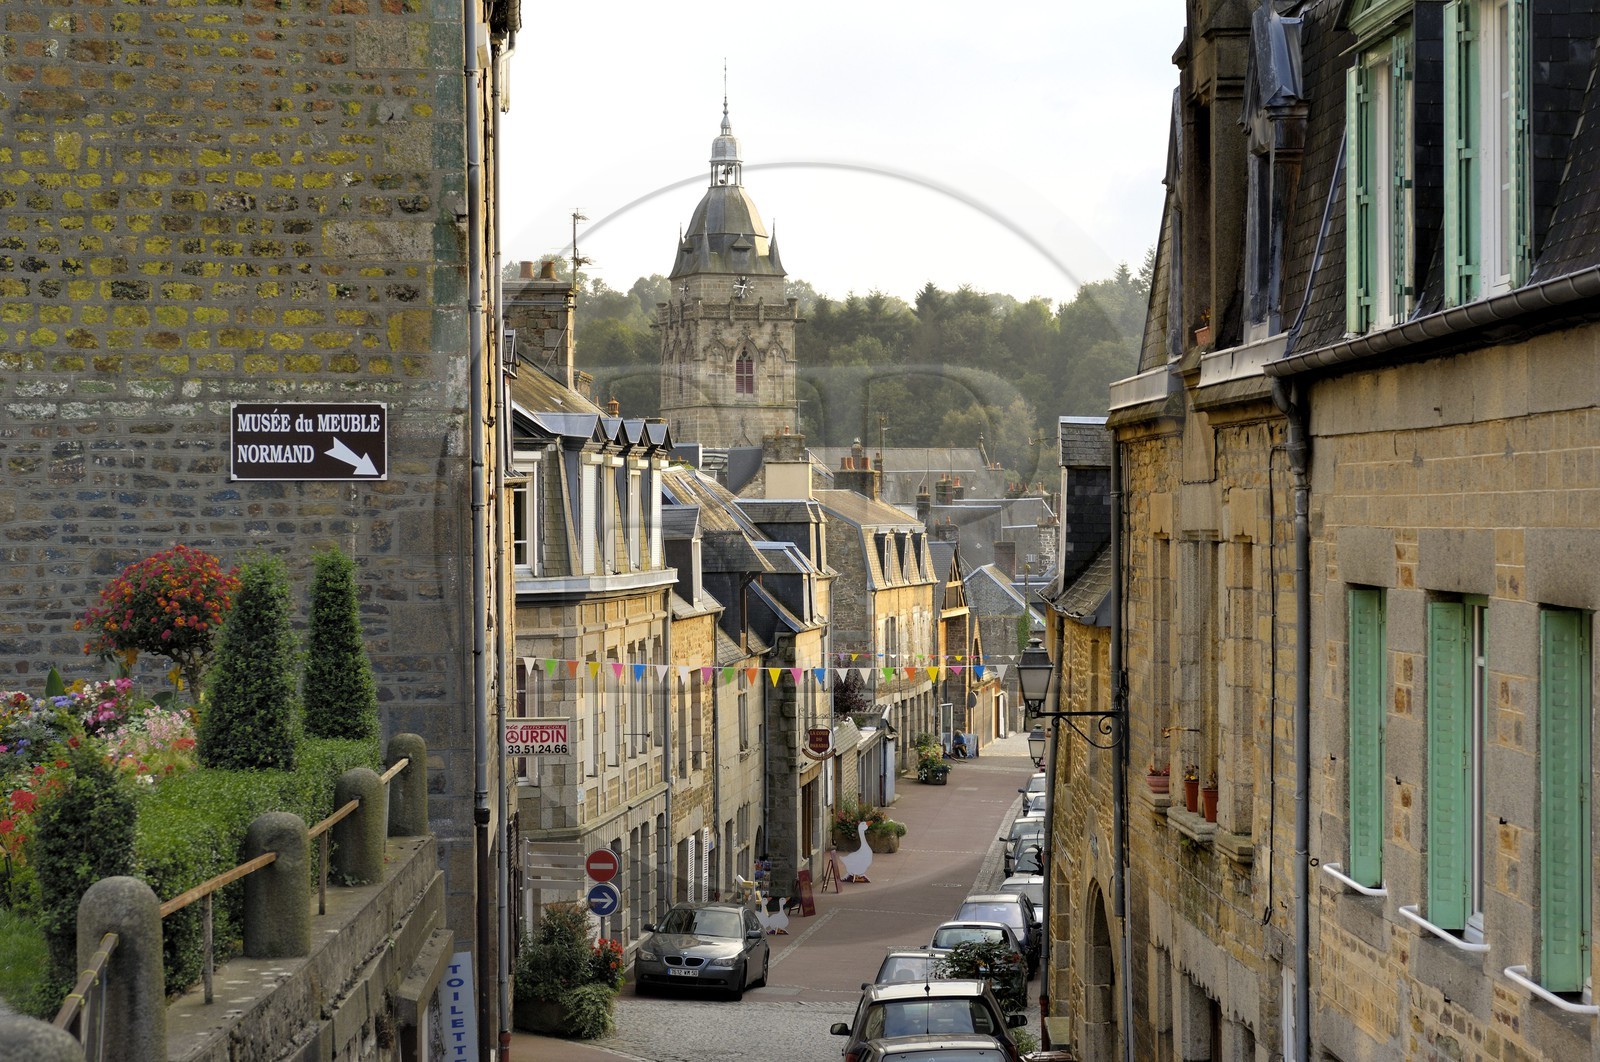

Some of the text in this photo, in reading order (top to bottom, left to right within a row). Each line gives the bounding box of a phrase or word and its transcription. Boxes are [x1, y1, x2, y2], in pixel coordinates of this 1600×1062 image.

[237, 408, 381, 433] MUSÉE du MEUBLE
[237, 444, 315, 464] NORMAND
[446, 964, 467, 1062] TOILETT
